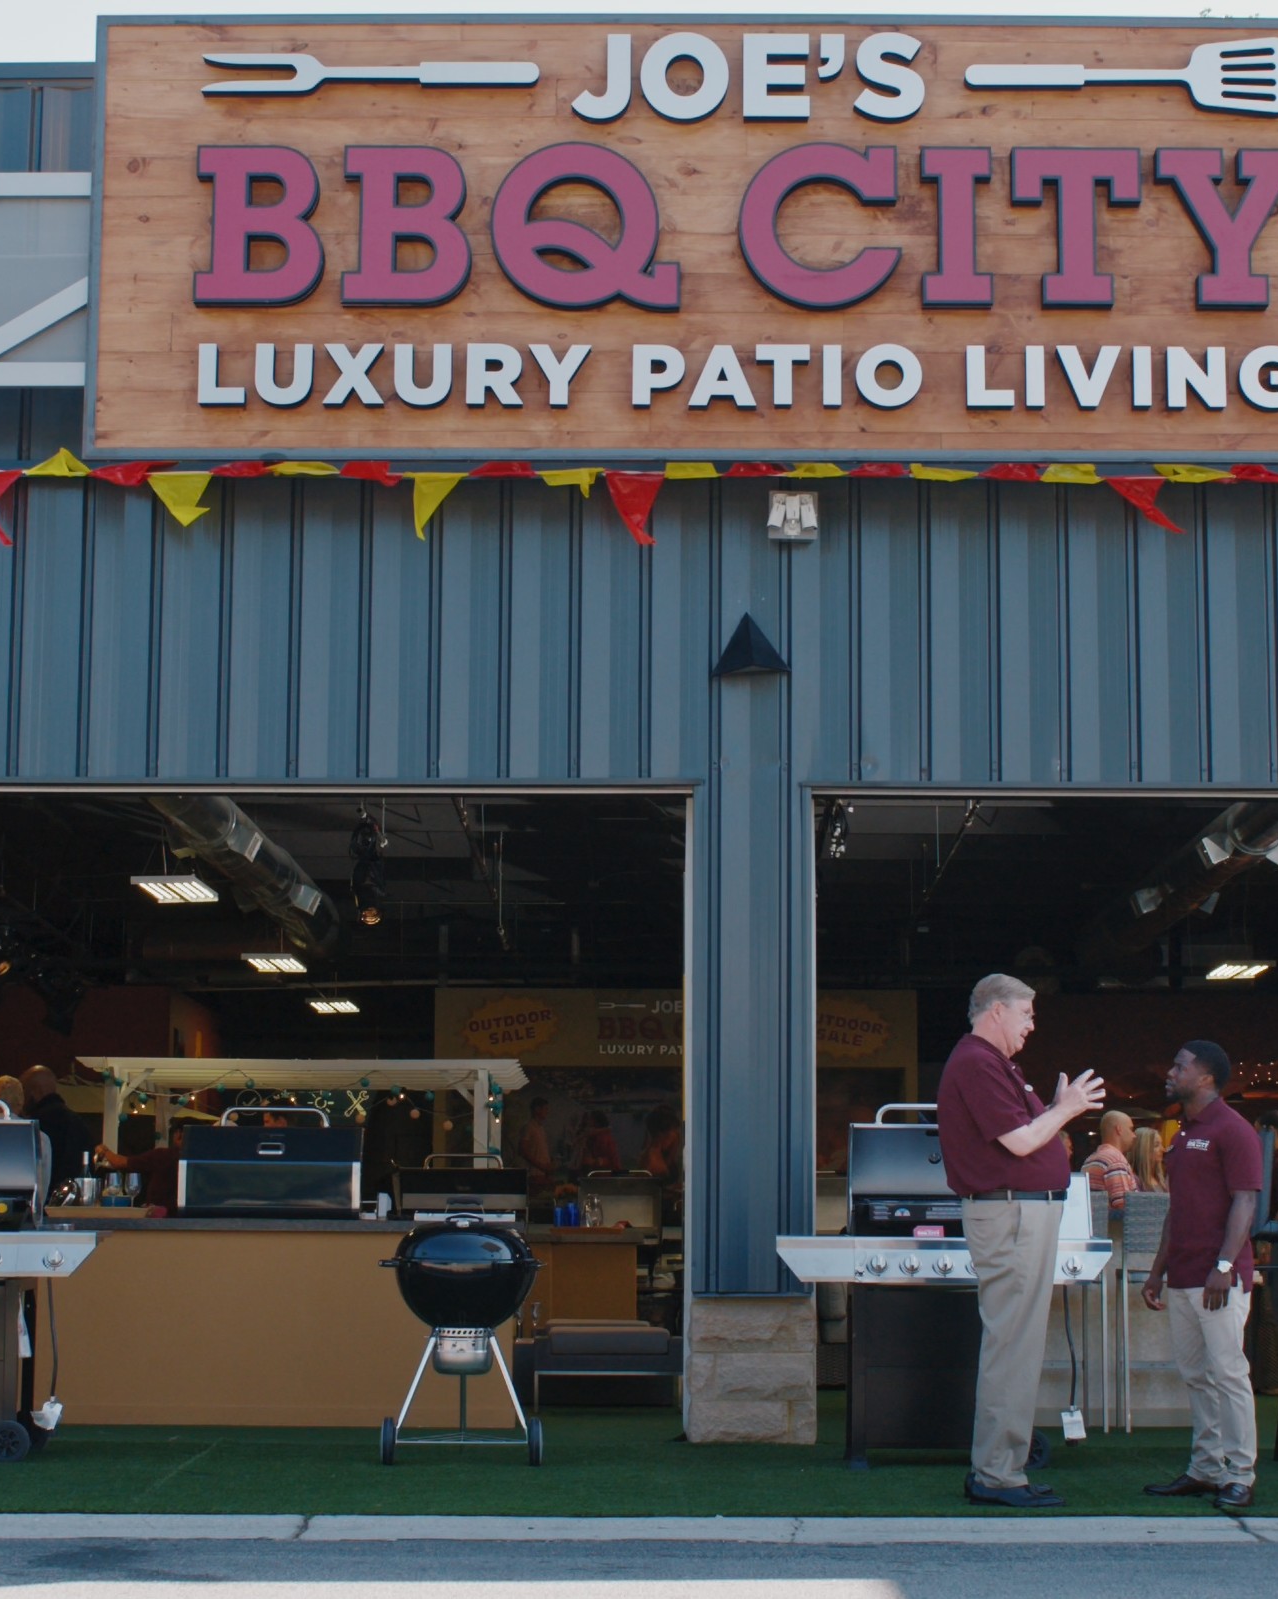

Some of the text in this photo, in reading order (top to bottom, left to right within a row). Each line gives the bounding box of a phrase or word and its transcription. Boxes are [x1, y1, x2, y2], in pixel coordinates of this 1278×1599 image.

[572, 32, 925, 121] JOE'S
[193, 141, 681, 312] BBQ
[197, 341, 591, 408] LUXURY
[632, 342, 925, 410] PATIO
[469, 1009, 552, 1032] OUTDOOR
[598, 1016, 668, 1040] BBQ
[488, 1026, 537, 1045] SALE
[817, 1028, 864, 1047] SALE
[599, 1044, 655, 1055] LUXURY
